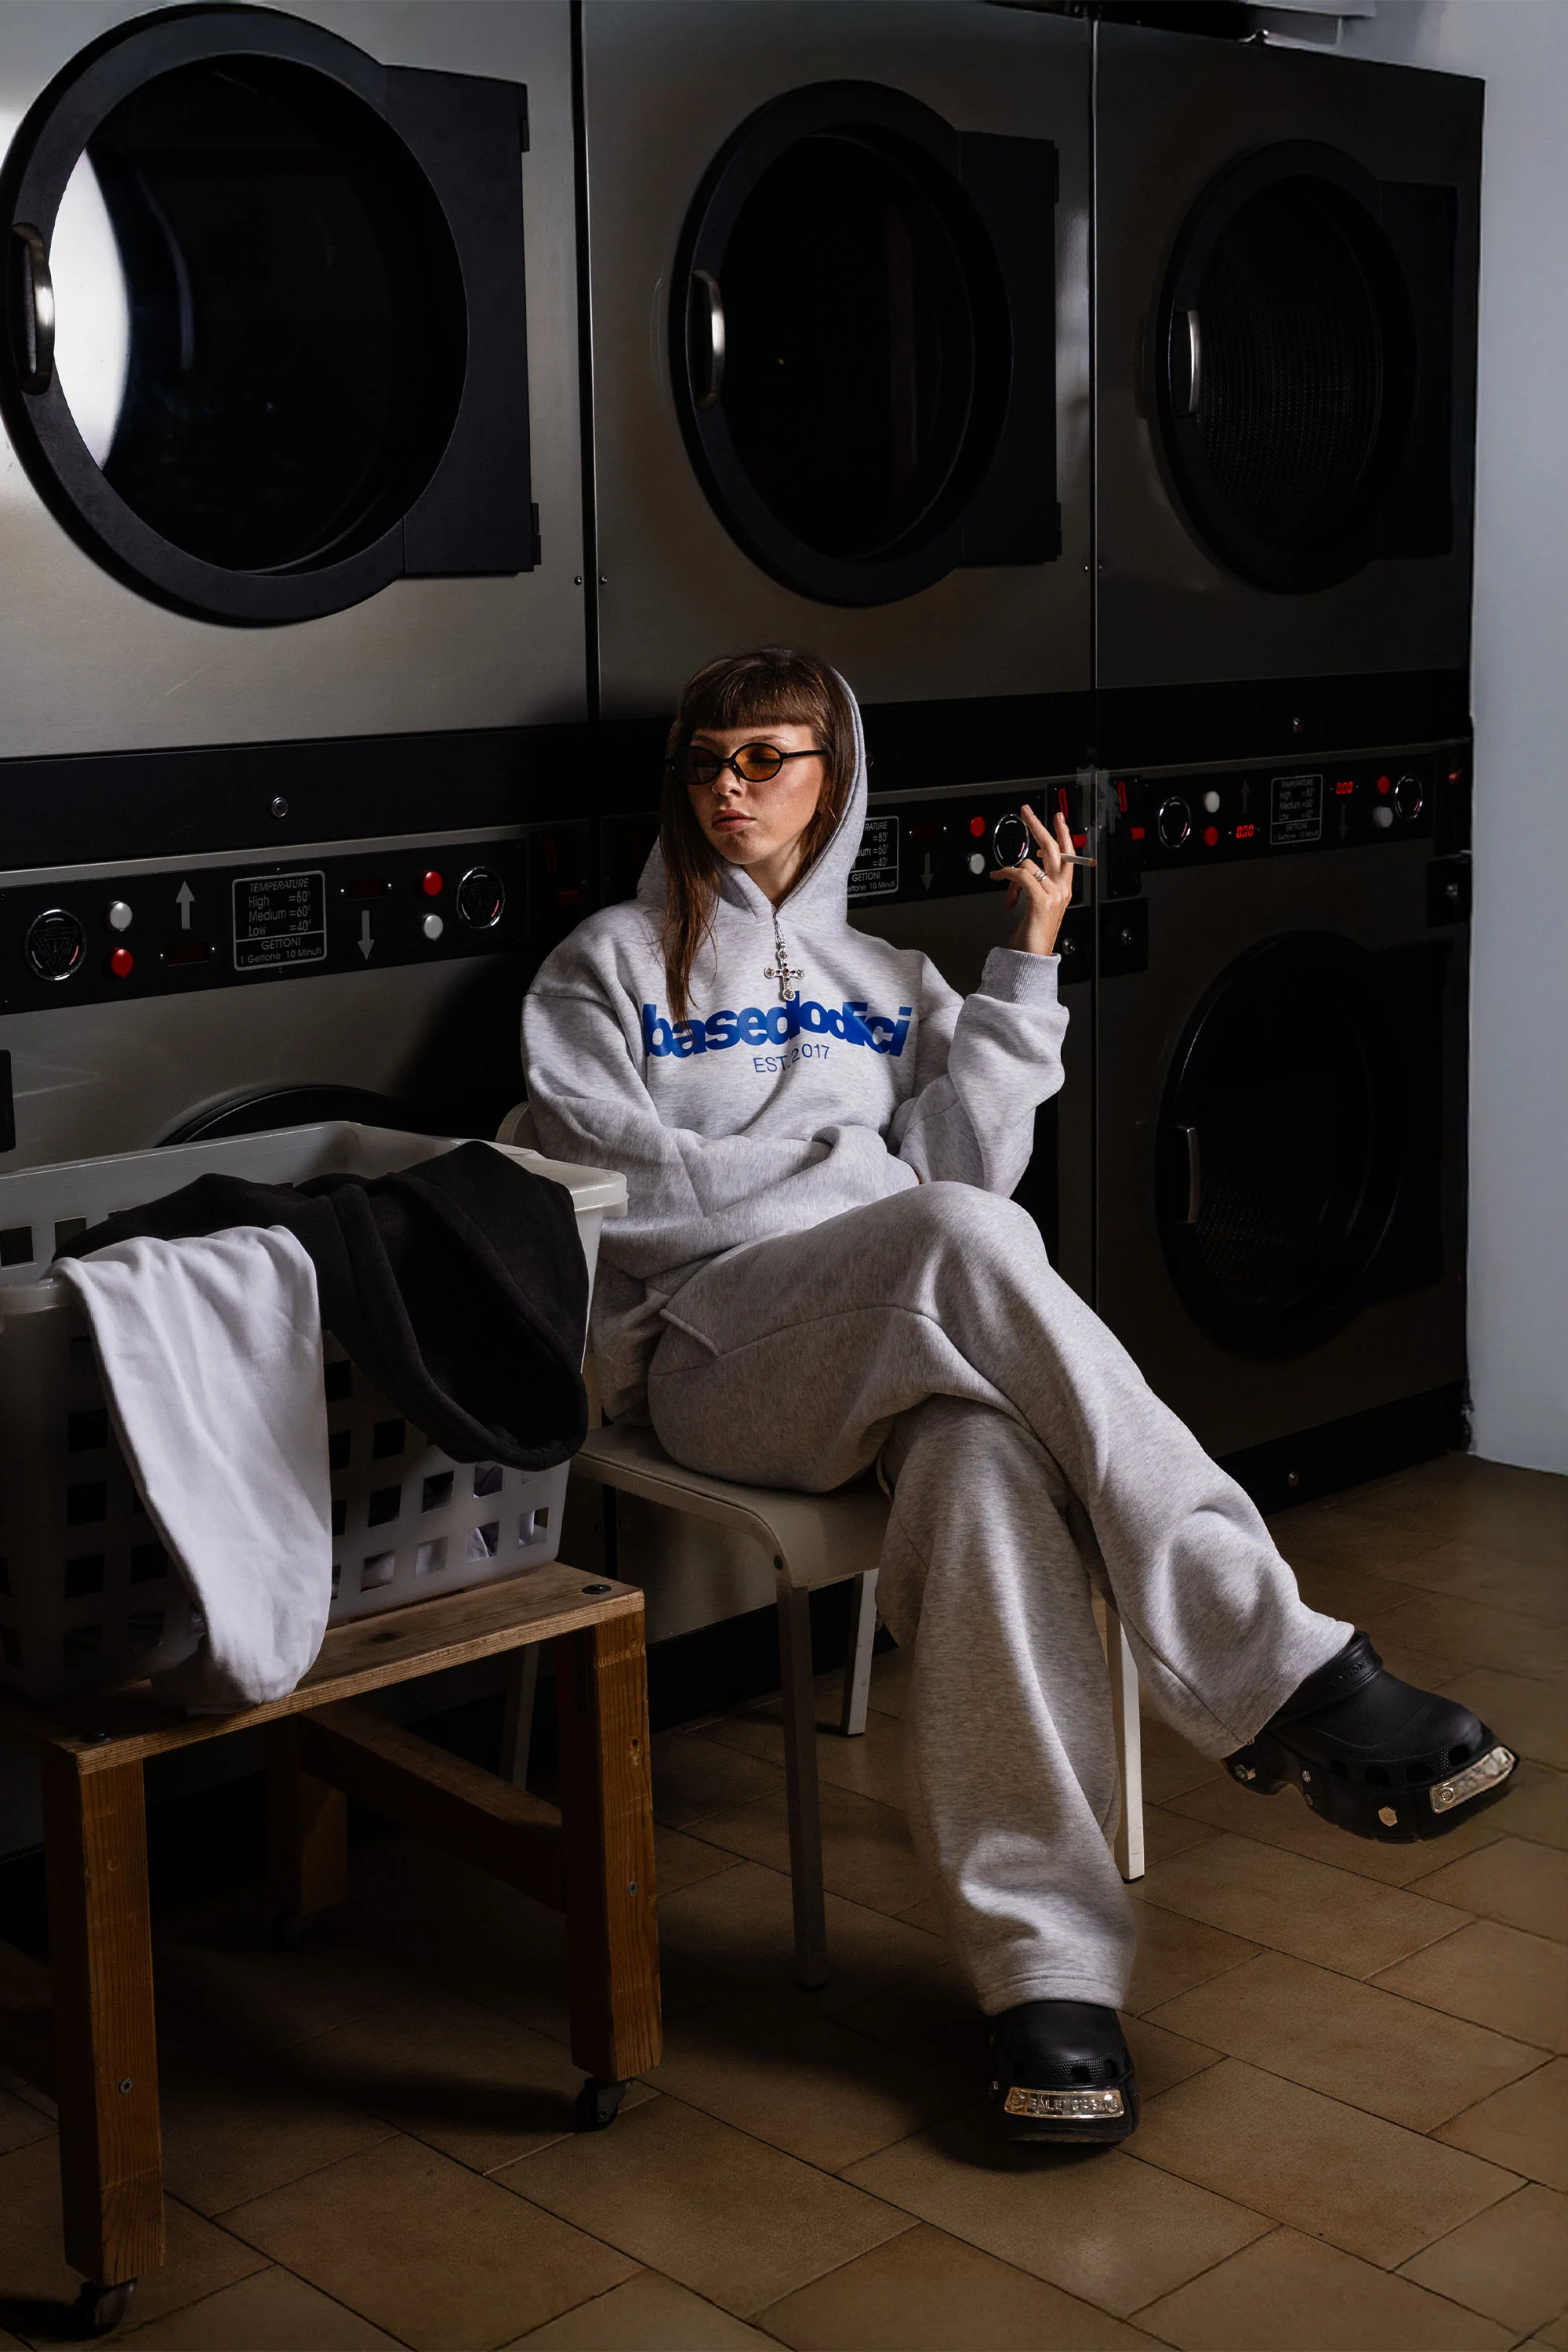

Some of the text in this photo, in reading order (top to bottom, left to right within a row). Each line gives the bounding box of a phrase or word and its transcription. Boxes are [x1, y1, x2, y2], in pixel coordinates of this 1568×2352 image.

[864, 821, 887, 831] RATURE
[851, 871, 880, 882] GETTONI
[250, 878, 309, 892] TEMPERATURE
[249, 894, 270, 909] High
[249, 909, 286, 923] Medium
[249, 925, 267, 937] Low
[261, 937, 301, 950] GETTONI
[247, 953, 281, 964] Gettone
[285, 949, 296, 958] 10
[298, 947, 321, 957] Minuti
